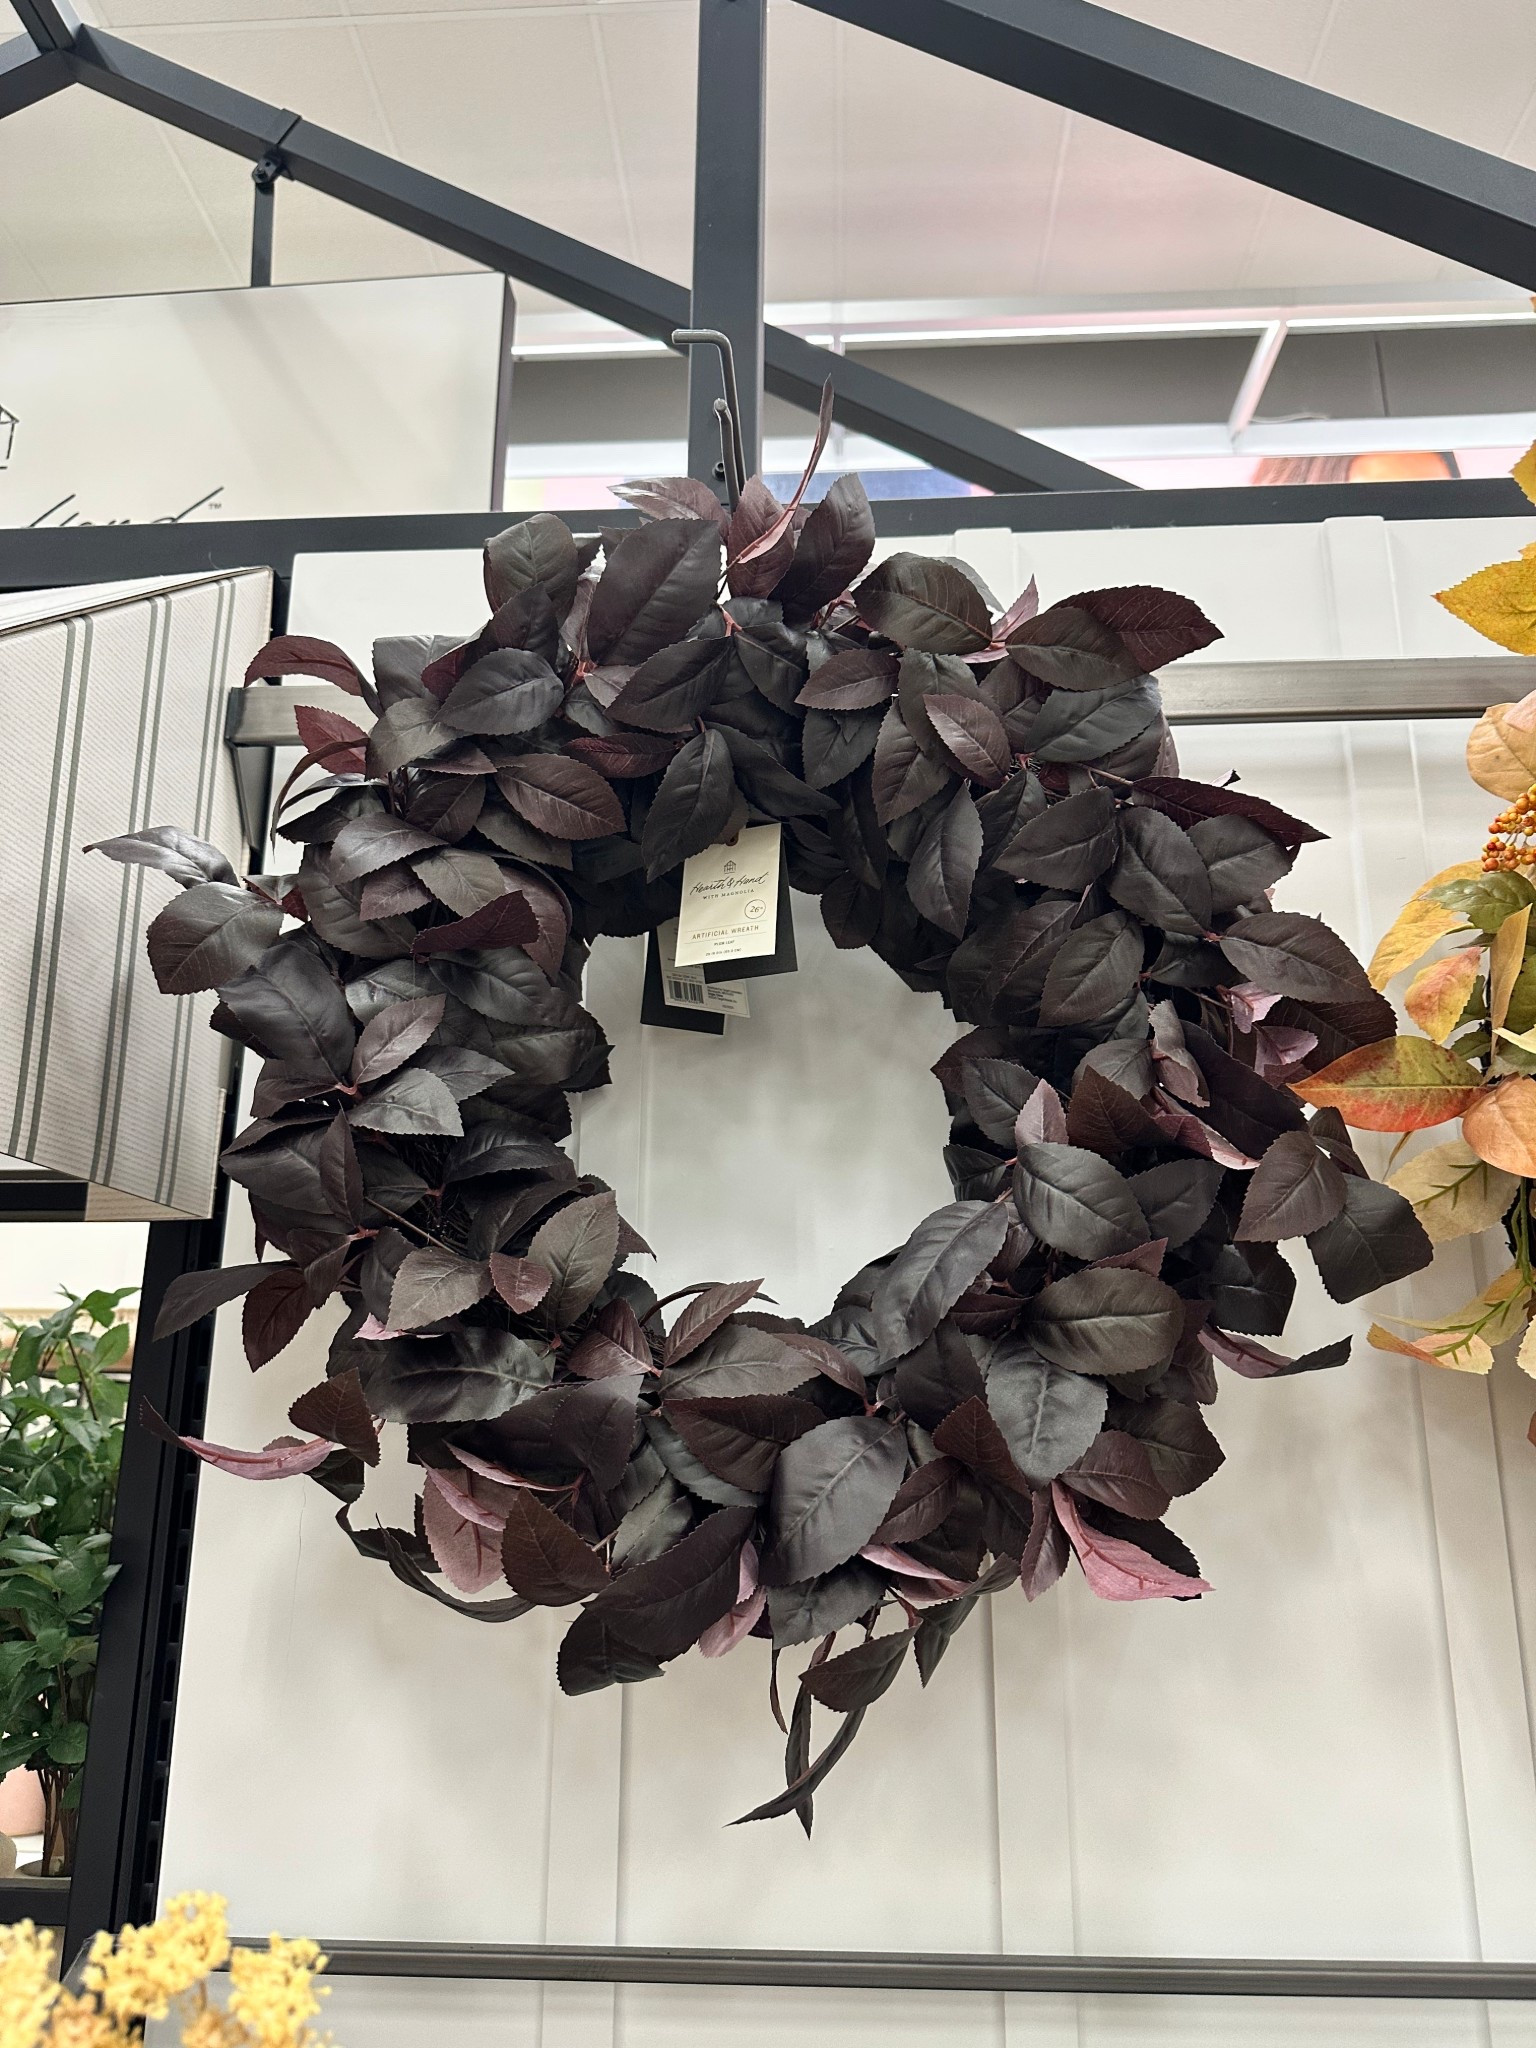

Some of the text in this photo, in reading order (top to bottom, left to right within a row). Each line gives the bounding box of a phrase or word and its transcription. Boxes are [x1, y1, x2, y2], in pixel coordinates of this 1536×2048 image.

[689, 872, 769, 896] Hearth & Hand
[720, 888, 755, 898] MAGNOLIA
[692, 925, 759, 940] ARTIFICIAL WREATH
